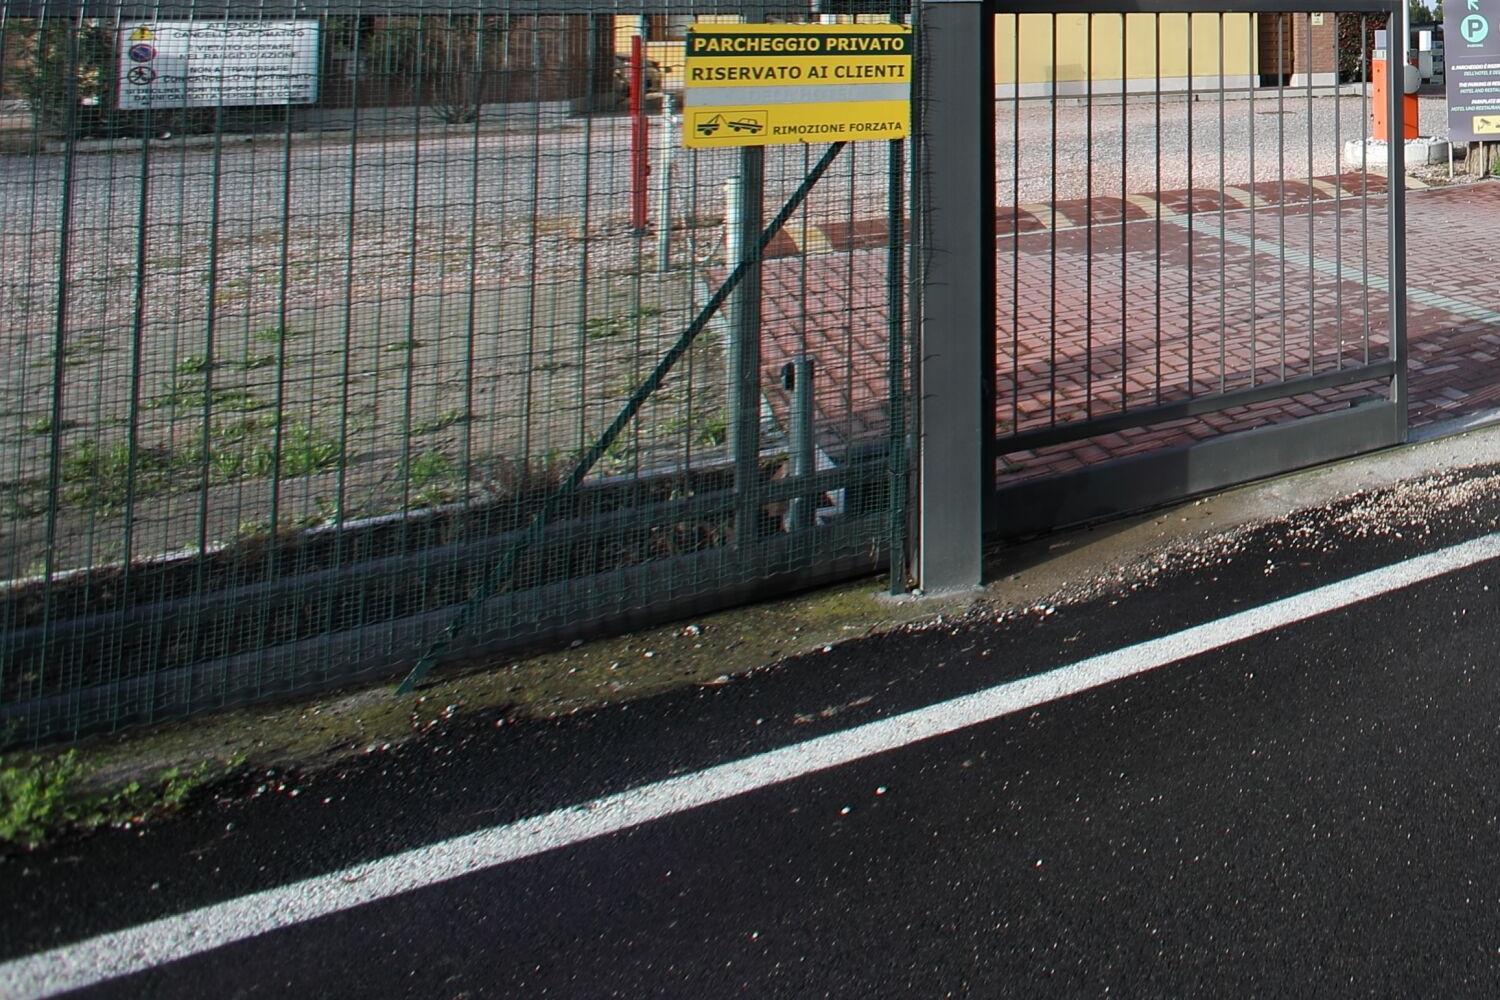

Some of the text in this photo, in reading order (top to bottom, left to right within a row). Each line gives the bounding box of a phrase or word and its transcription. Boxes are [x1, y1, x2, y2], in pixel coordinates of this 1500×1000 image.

[236, 30, 305, 38] AUTOMATICO
[1468, 19, 1483, 38] P
[694, 37, 904, 52] PARCHEGGIO PRIVATO
[692, 64, 905, 81] RISERVATO AI CLIENTI
[773, 122, 902, 135] RIMOZIONE FORZATA
